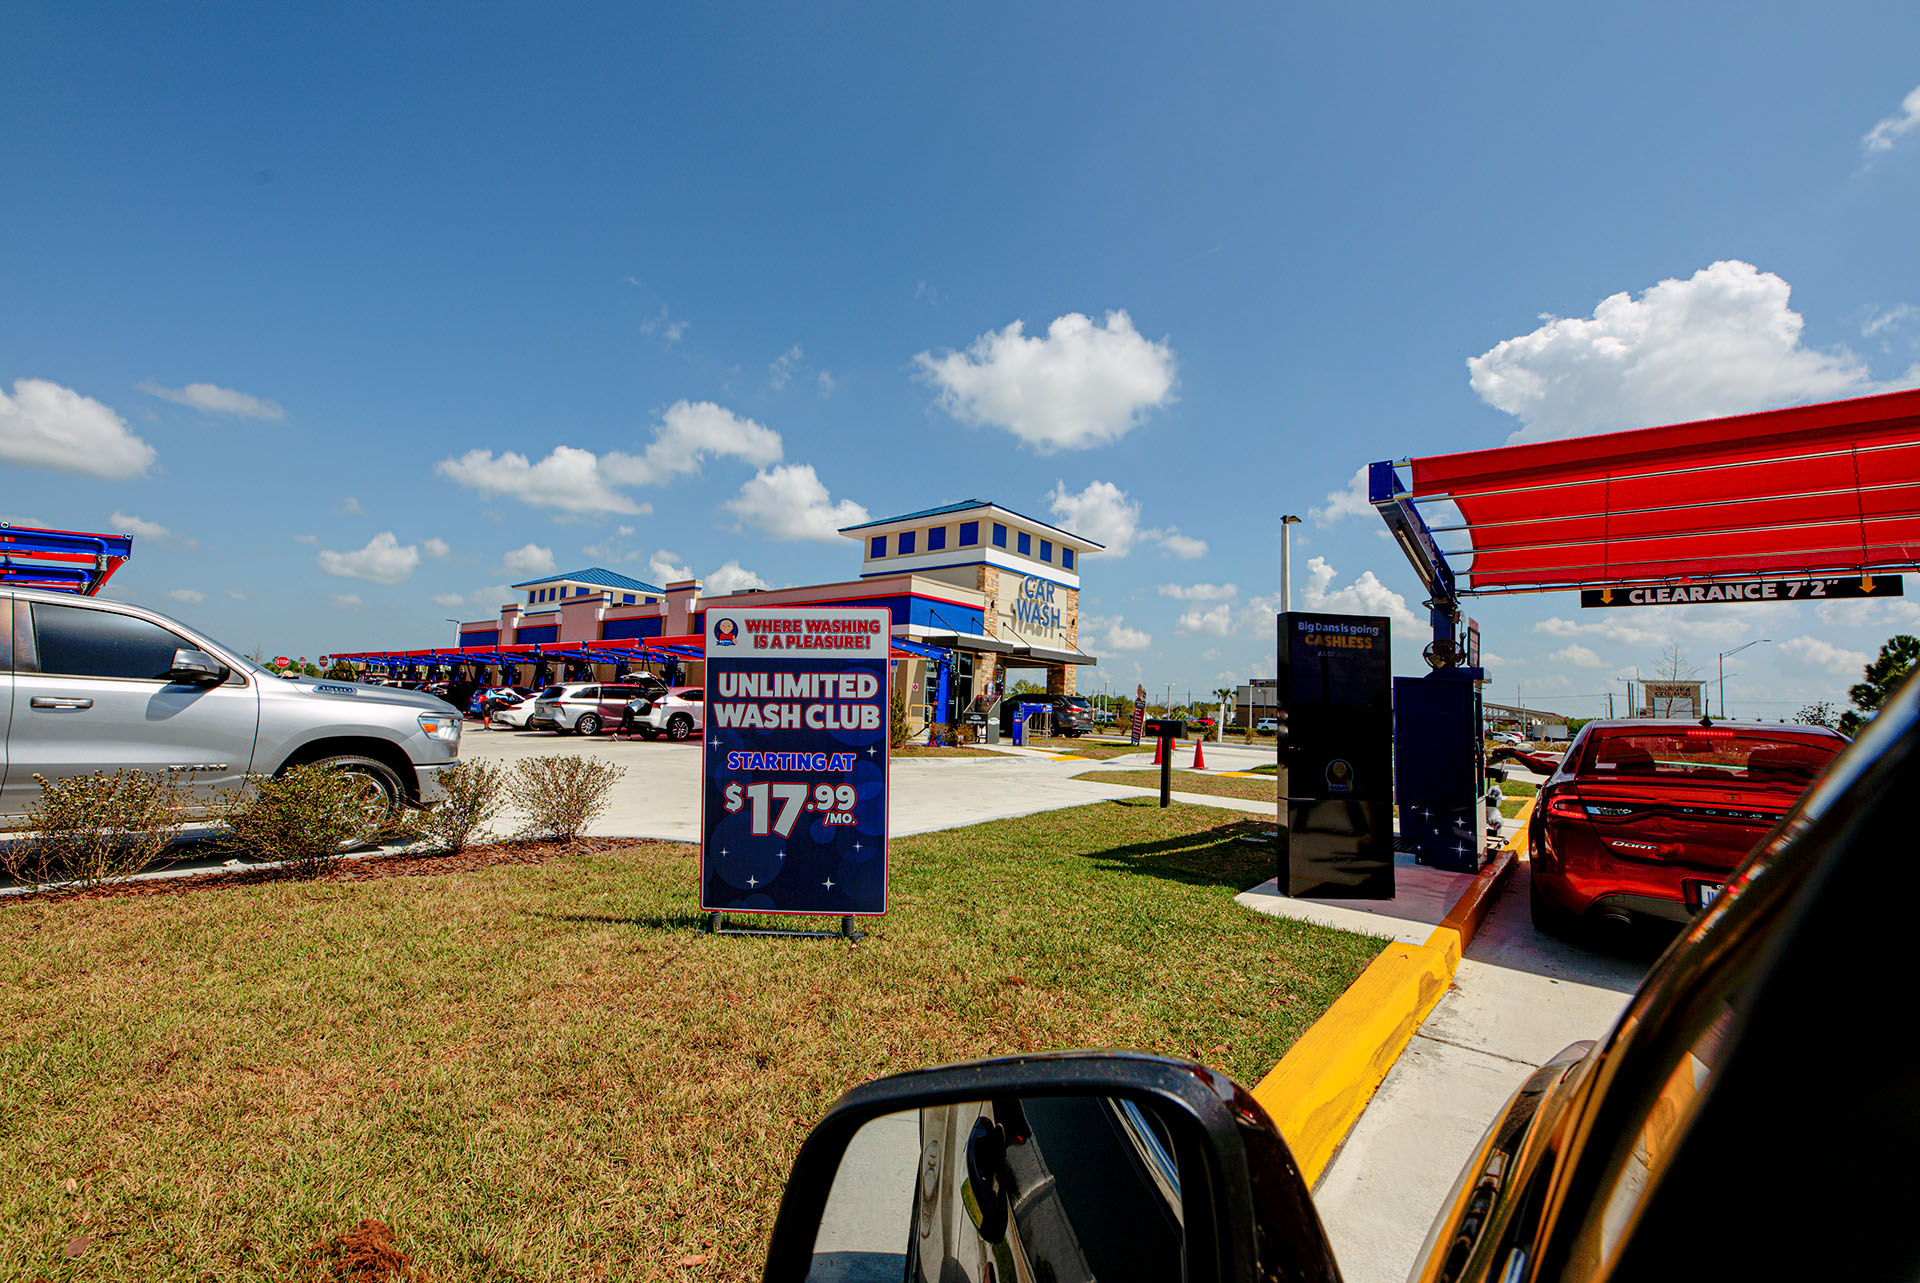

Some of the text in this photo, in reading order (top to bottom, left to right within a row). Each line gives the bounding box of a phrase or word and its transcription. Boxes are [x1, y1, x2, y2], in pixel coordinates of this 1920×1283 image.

[1024, 575, 1055, 604] CAR
[1628, 579, 1839, 605] CLEARANCE 7'2"
[1016, 597, 1061, 629] WASH
[744, 618, 881, 634] WHERE WASHING
[1297, 620, 1315, 633] Big
[1340, 623, 1349, 633] is
[1349, 624, 1380, 637] going
[753, 634, 871, 650] IS A PLEASURE!
[1303, 633, 1374, 649] CASHLESS
[718, 671, 880, 700] UNLIMITED
[713, 702, 882, 731] WASH CLUB
[726, 750, 858, 772] STARTING AT
[723, 780, 858, 838] $17.99
[822, 811, 858, 826] /MO.
